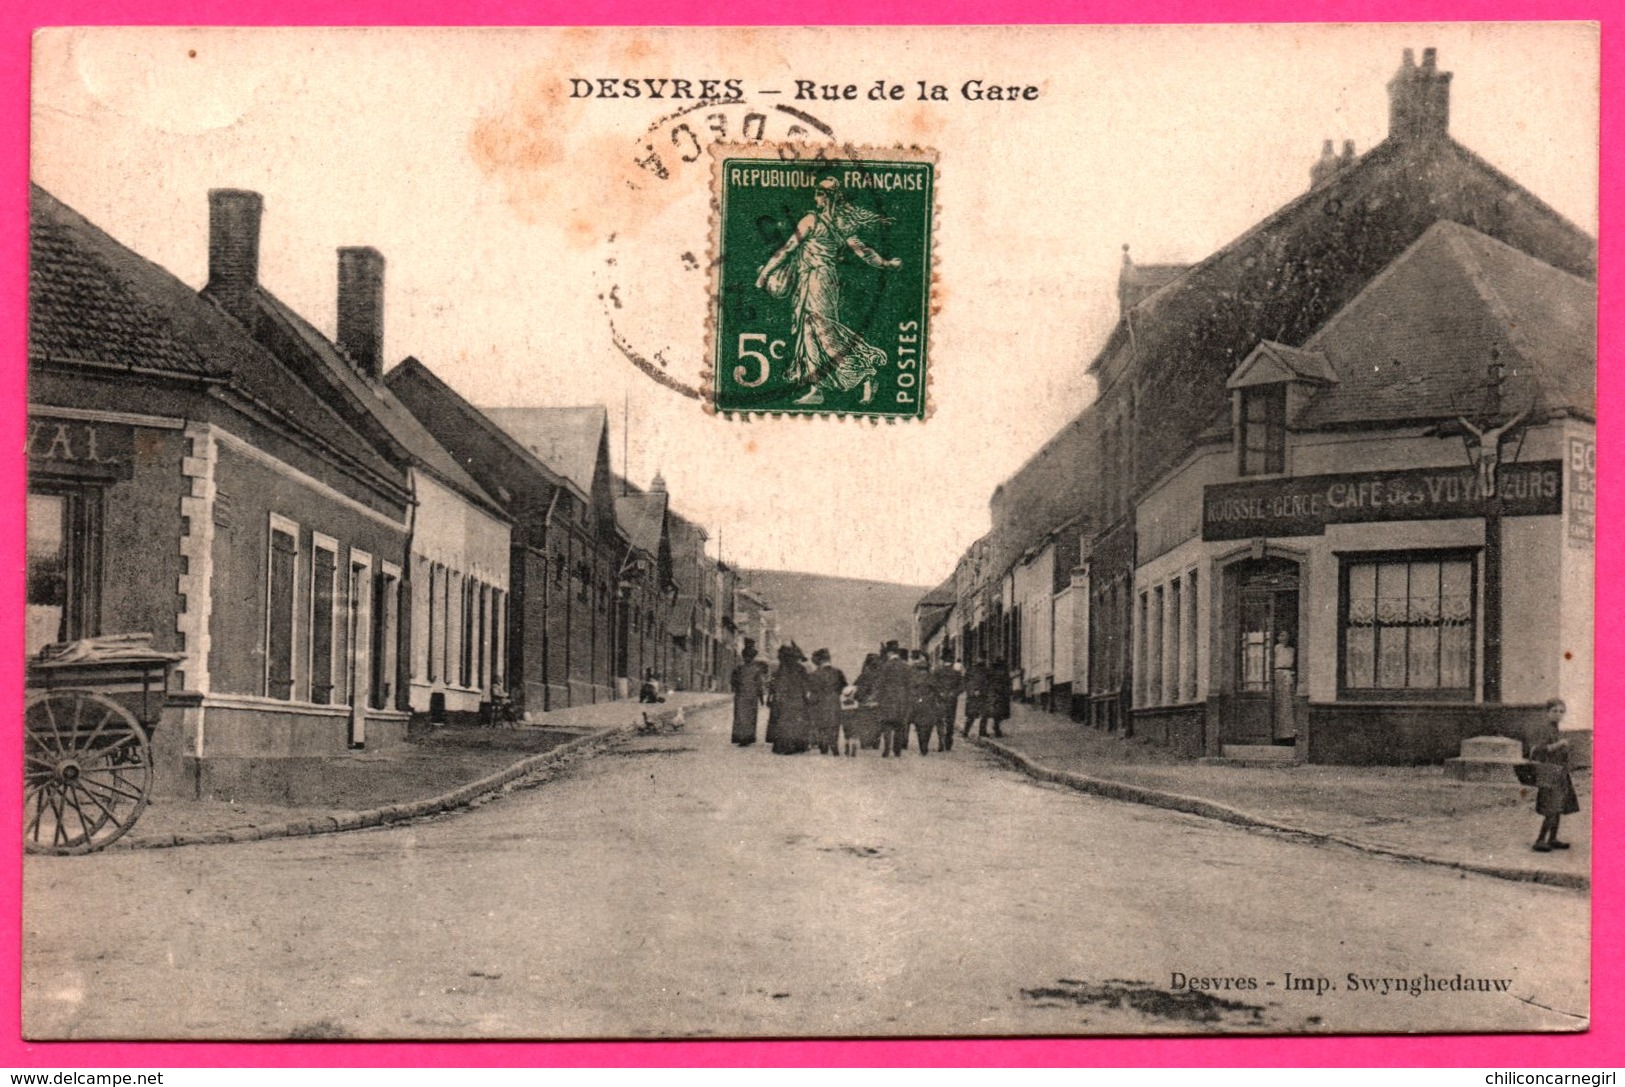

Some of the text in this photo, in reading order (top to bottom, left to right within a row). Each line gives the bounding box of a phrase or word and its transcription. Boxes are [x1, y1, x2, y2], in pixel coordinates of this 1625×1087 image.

[569, 78, 744, 99] DESVRES
[794, 79, 858, 101] Rue
[867, 80, 905, 100] de
[917, 80, 949, 101] la
[961, 79, 1039, 101] Gare
[843, 171, 924, 192] FRANÇAISE
[895, 320, 918, 403] POSTES
[1170, 972, 1258, 991] Desvres
[1284, 972, 1337, 996] Imp.
[1347, 972, 1513, 996] Swynghedauw
